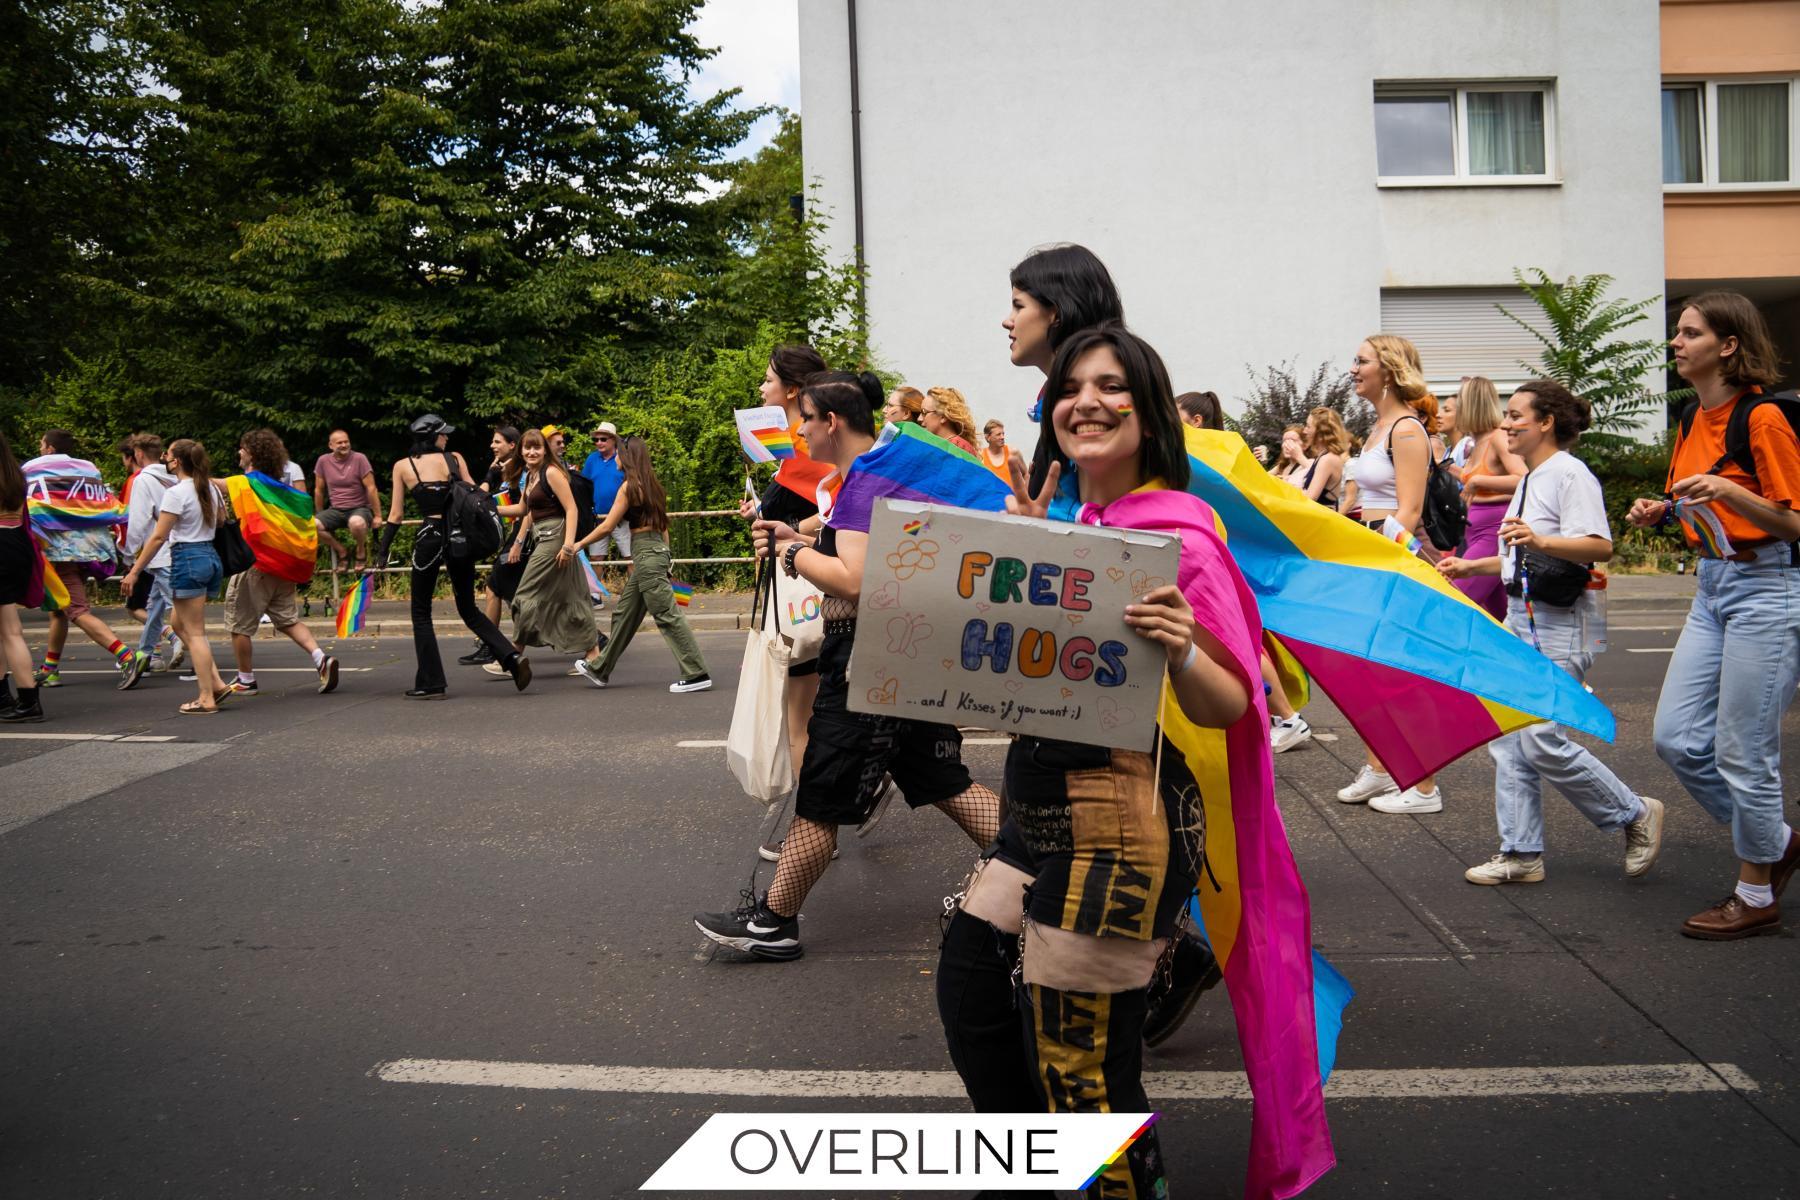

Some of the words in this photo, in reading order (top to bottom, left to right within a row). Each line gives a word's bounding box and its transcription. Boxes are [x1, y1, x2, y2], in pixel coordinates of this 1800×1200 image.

[956, 551, 1094, 611] FREE
[1000, 699, 1014, 720] if
[1013, 705, 1036, 724] you
[1040, 705, 1068, 717] want
